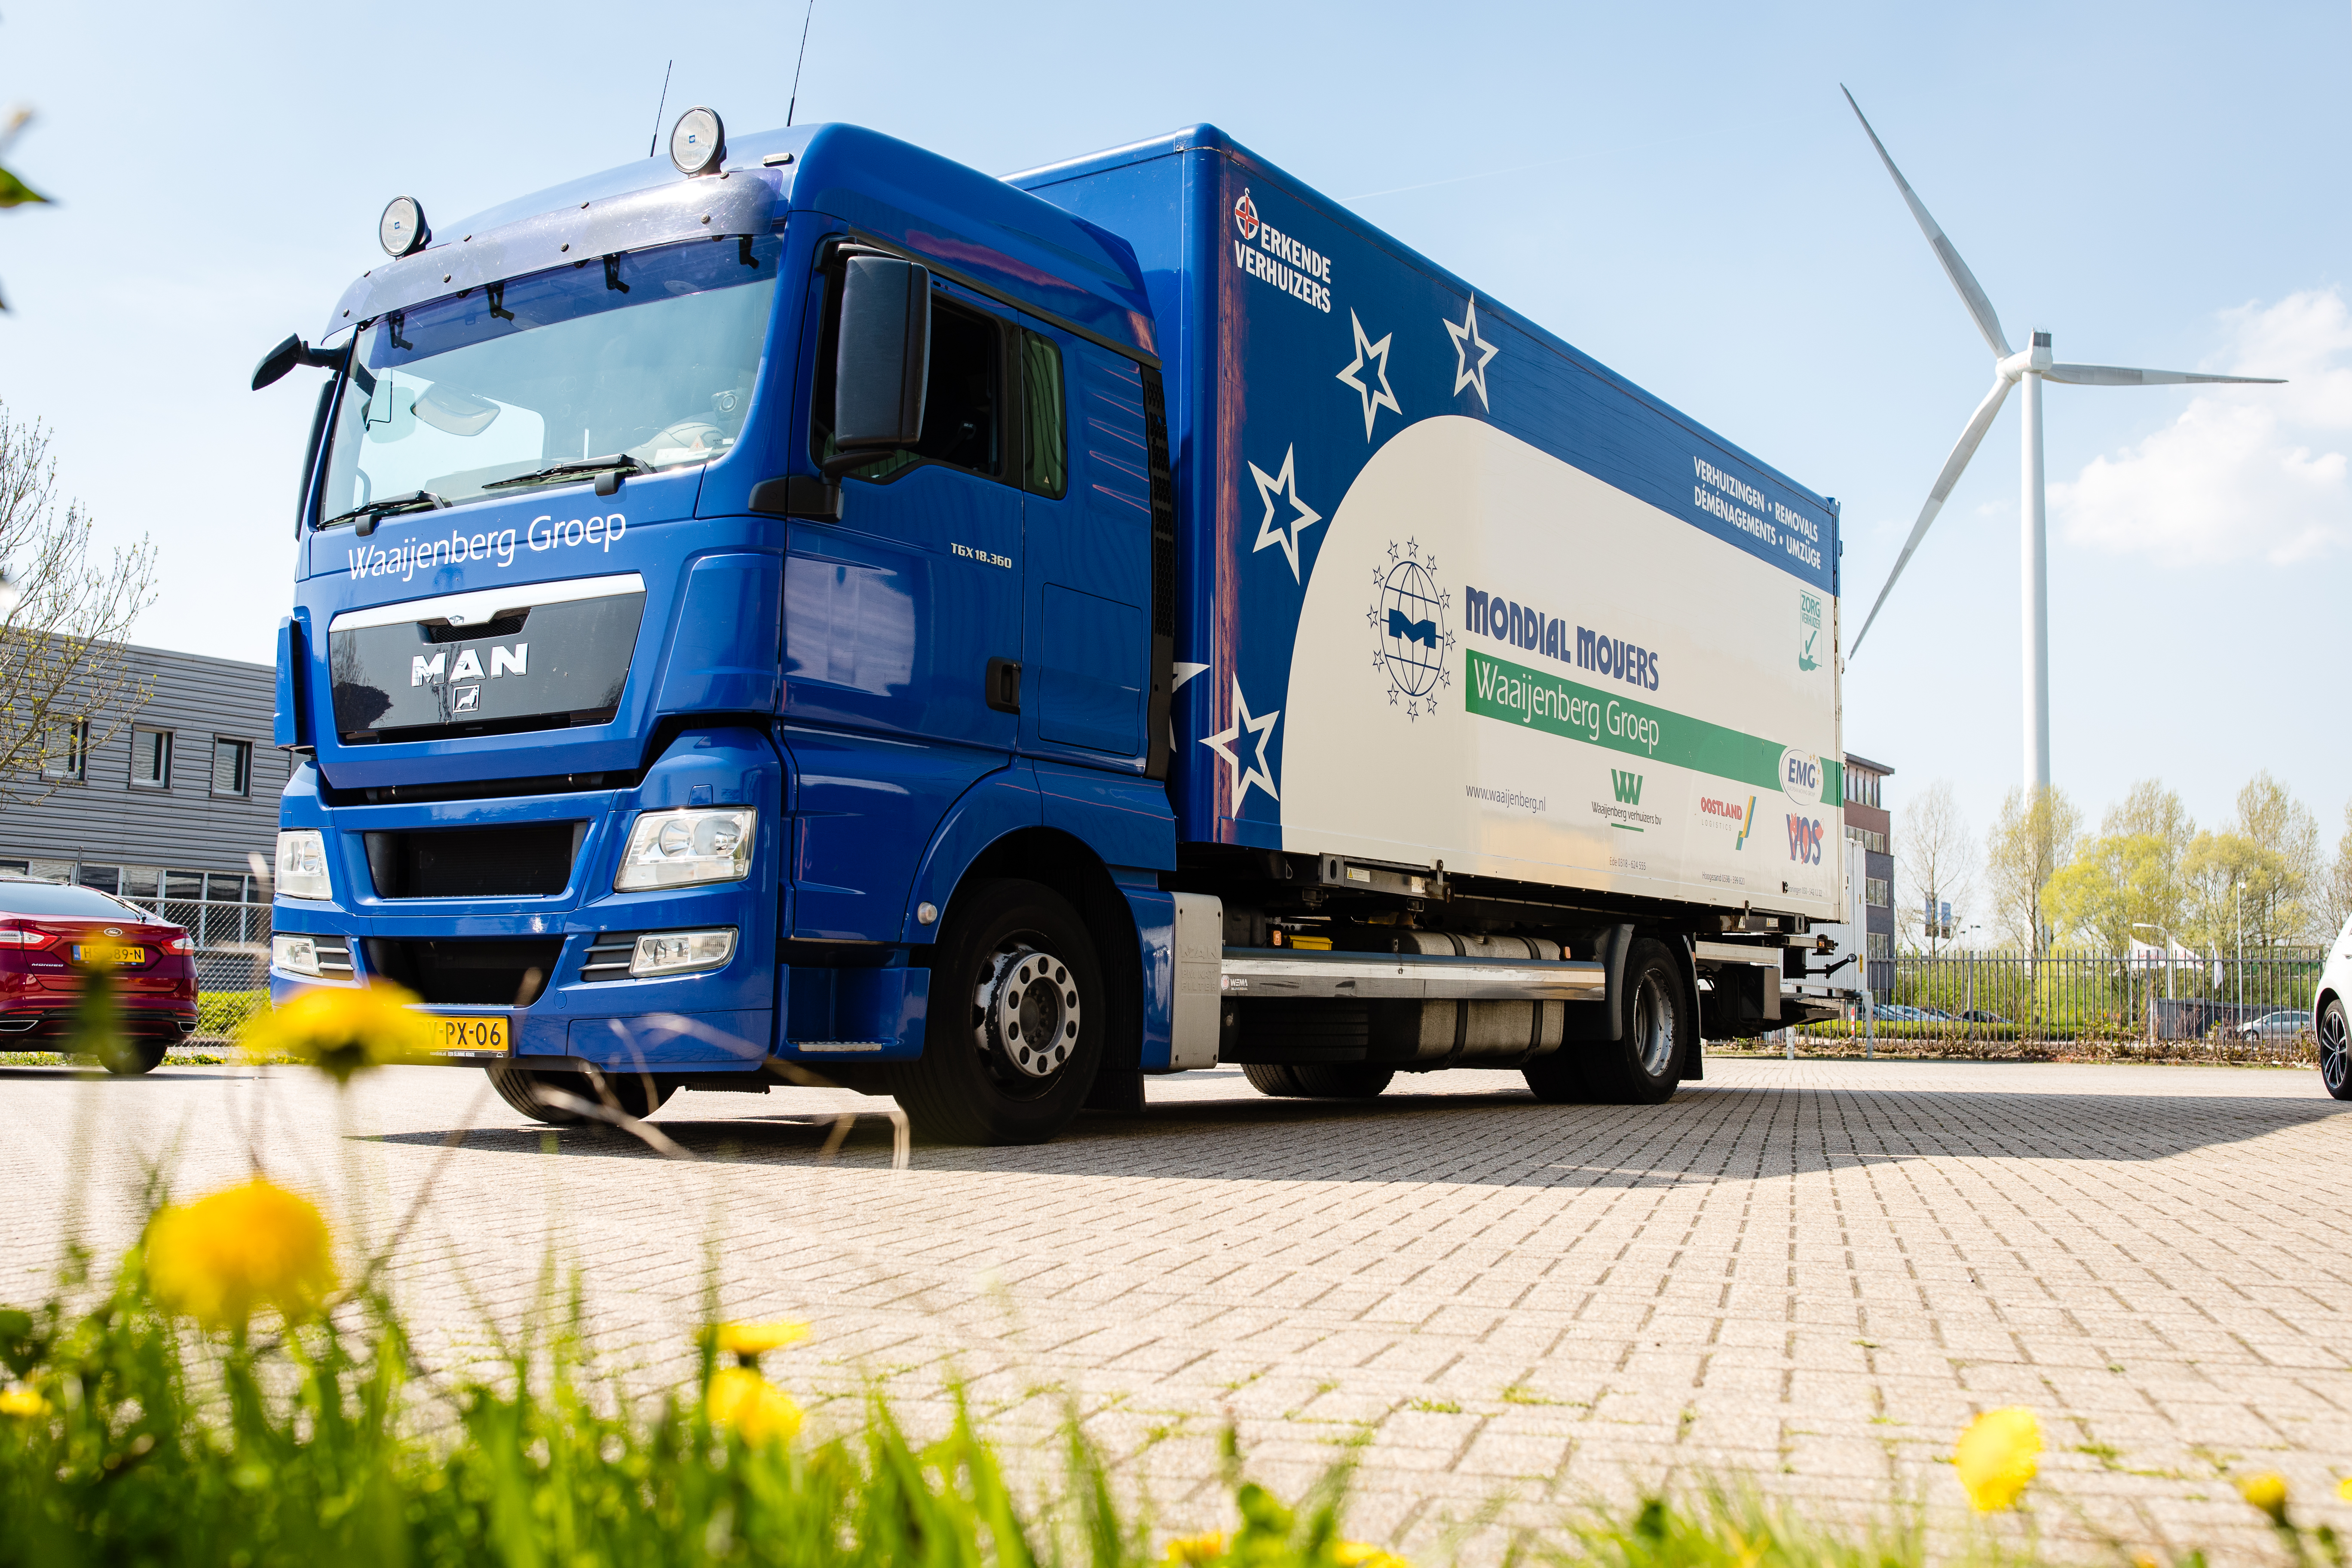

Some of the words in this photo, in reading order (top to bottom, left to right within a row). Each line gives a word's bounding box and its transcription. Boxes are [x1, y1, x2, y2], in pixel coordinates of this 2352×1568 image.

[1261, 222, 1331, 284] ERKENDE
[1234, 240, 1331, 314] VERHUIZERS
[1693, 455, 1764, 512] VERHUIZINGEN
[1775, 501, 1818, 542] REMOVALS
[1694, 483, 1776, 545] DÉMÉNAGEMENTS
[1786, 534, 1821, 570] UMZÜGE
[348, 528, 516, 582] Waaijenberg
[527, 513, 626, 552] Groep
[950, 542, 974, 558] TGX
[975, 550, 1012, 569] 18.360
[1801, 594, 1820, 618] ZORG
[1801, 611, 1821, 630] VERHUIZER
[1466, 585, 1571, 664] MONDIAL
[1577, 625, 1659, 691] MOVERS
[411, 642, 529, 687] MAN
[1474, 658, 1599, 741] Waaijenberg
[1606, 700, 1660, 755] Groep
[1788, 757, 1816, 789] EMG
[1466, 785, 1546, 813] www.waaijenberg.nl
[1701, 796, 1743, 820] OOSTLAND
[1591, 801, 1627, 822] Waaijenberg
[1627, 810, 1654, 824] verhuizers
[1655, 814, 1662, 825] bv
[1701, 819, 1731, 831] LOGISTICS
[1786, 813, 1822, 866] VOS
[1617, 858, 1628, 867] 0318
[1702, 871, 1721, 882] Hoogezand
[1722, 874, 1730, 883] 0598
[1179, 944, 1219, 959] MAN
[1181, 983, 1216, 991] FILTER
[1230, 978, 1248, 986] WEMA
[416, 1021, 501, 1046] V-PX-06
